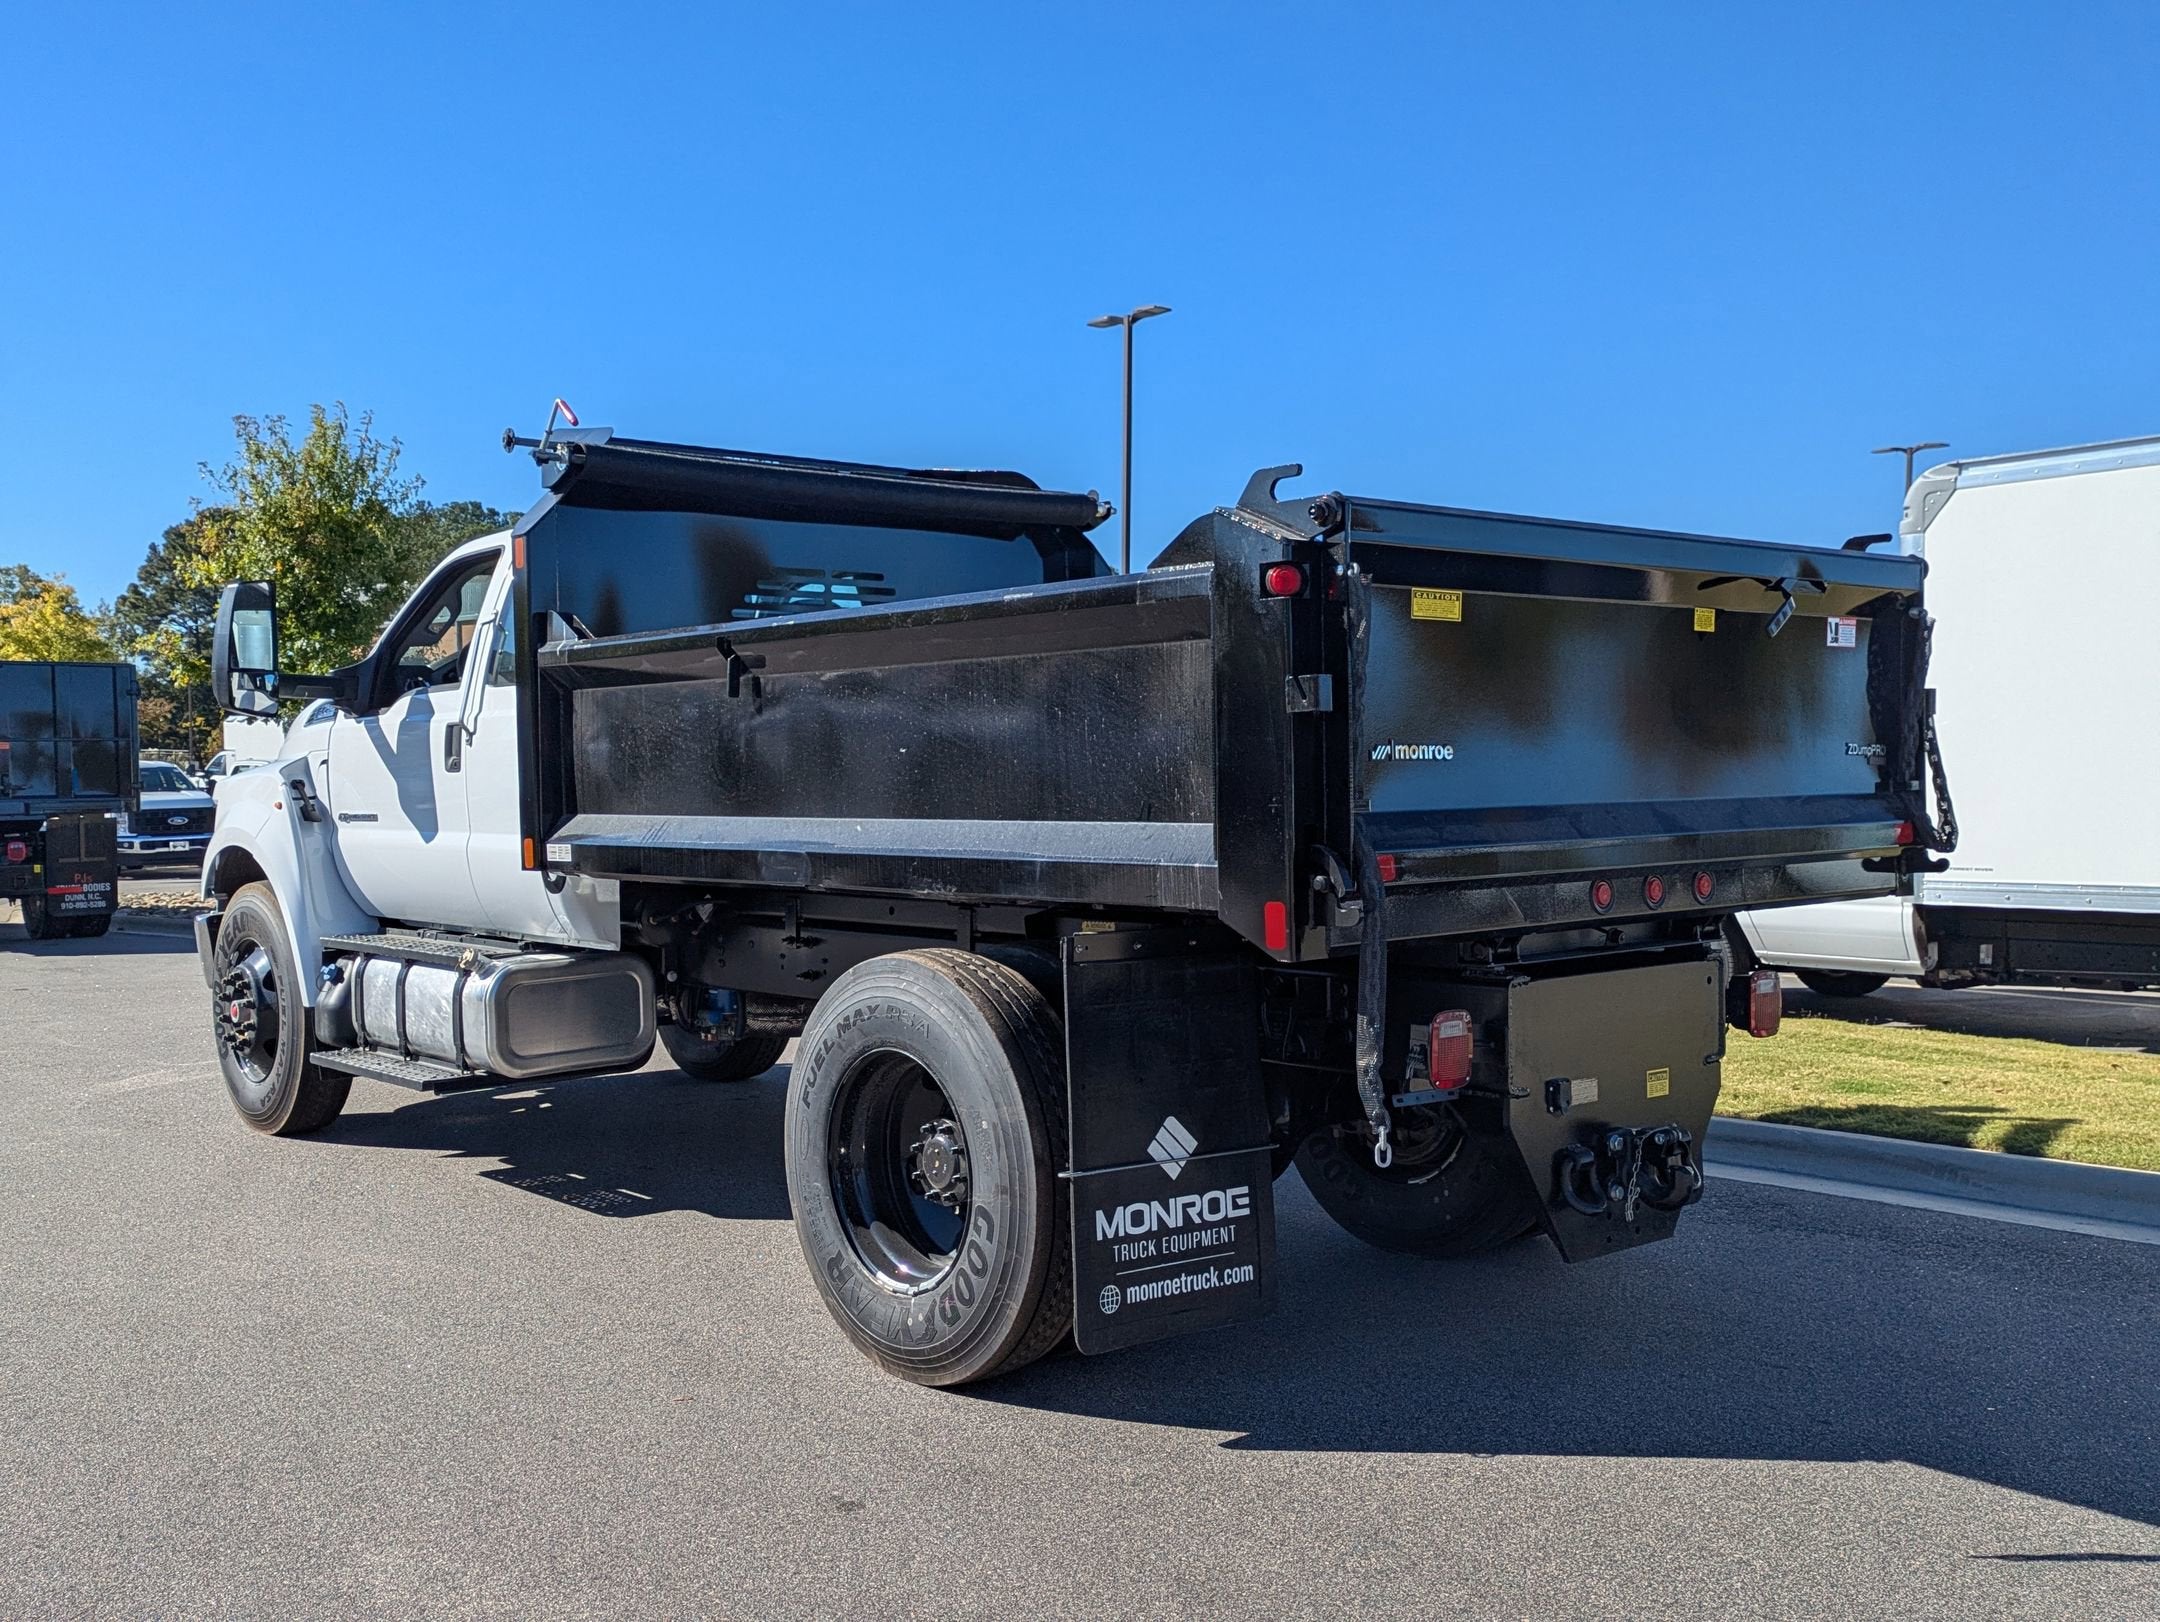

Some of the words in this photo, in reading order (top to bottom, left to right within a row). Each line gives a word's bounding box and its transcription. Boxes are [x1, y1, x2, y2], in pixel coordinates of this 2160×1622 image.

[1415, 592, 1458, 600] CAUTION
[1395, 744, 1454, 760] monroe
[82, 882, 111, 892] BODIES
[802, 1038, 836, 1110] FUEL
[836, 1004, 880, 1038] MAX
[885, 1004, 930, 1039] RSA
[1095, 1185, 1250, 1241] MONROE
[1112, 1239, 1157, 1263] TRUCK
[1162, 1225, 1236, 1254] EQUIPMENT
[1126, 1264, 1254, 1304] monroetruck.com
